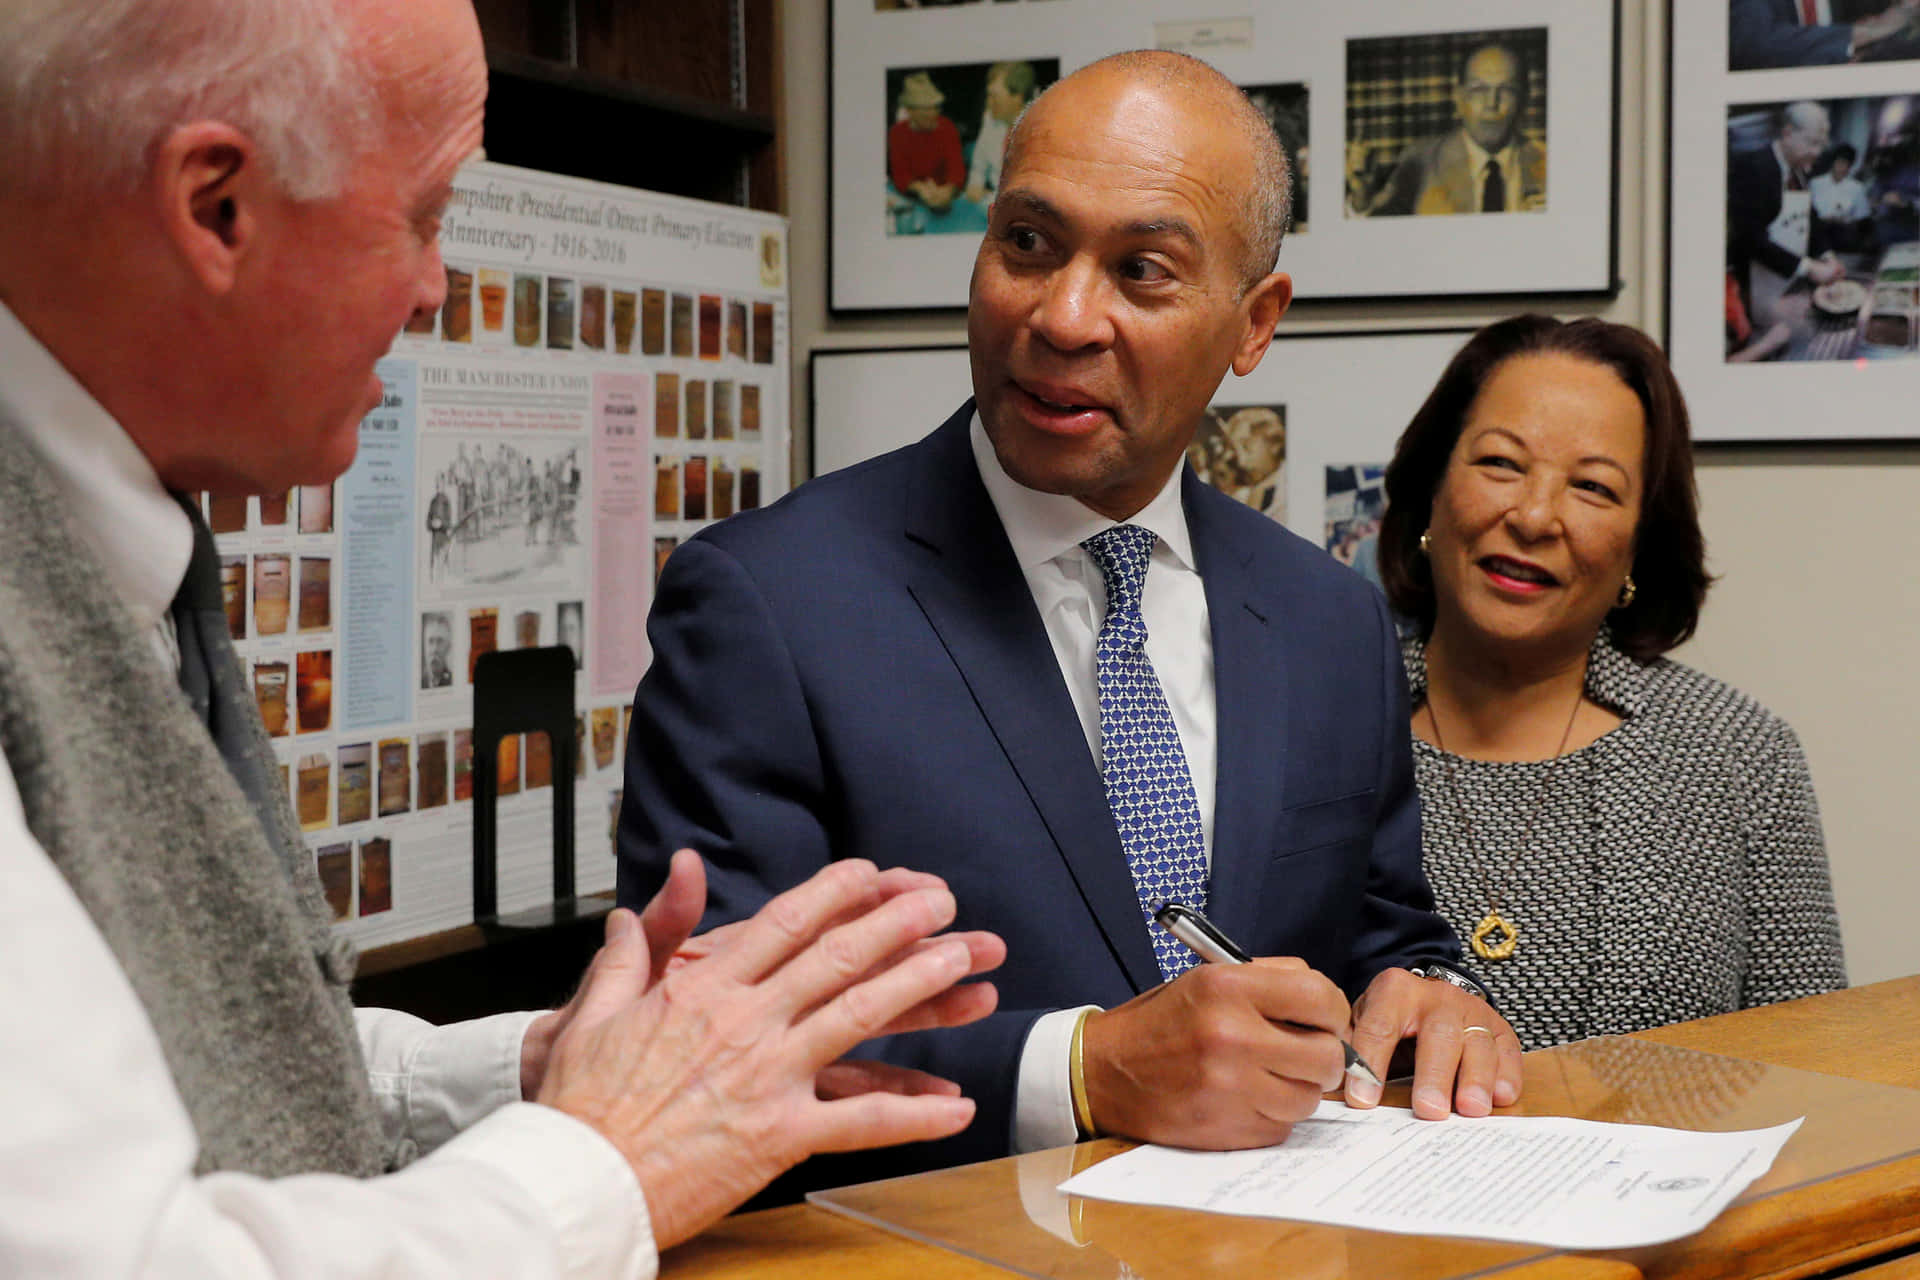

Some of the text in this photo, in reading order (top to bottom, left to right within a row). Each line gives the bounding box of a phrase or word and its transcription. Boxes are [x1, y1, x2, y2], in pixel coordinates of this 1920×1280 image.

[444, 216, 536, 261] Anniversary
[517, 191, 605, 227] Presidential
[606, 205, 649, 235] Direct
[652, 212, 702, 251] Primary
[704, 221, 755, 250] Election
[423, 368, 452, 384] THE
[456, 369, 547, 387] MANCHESTER
